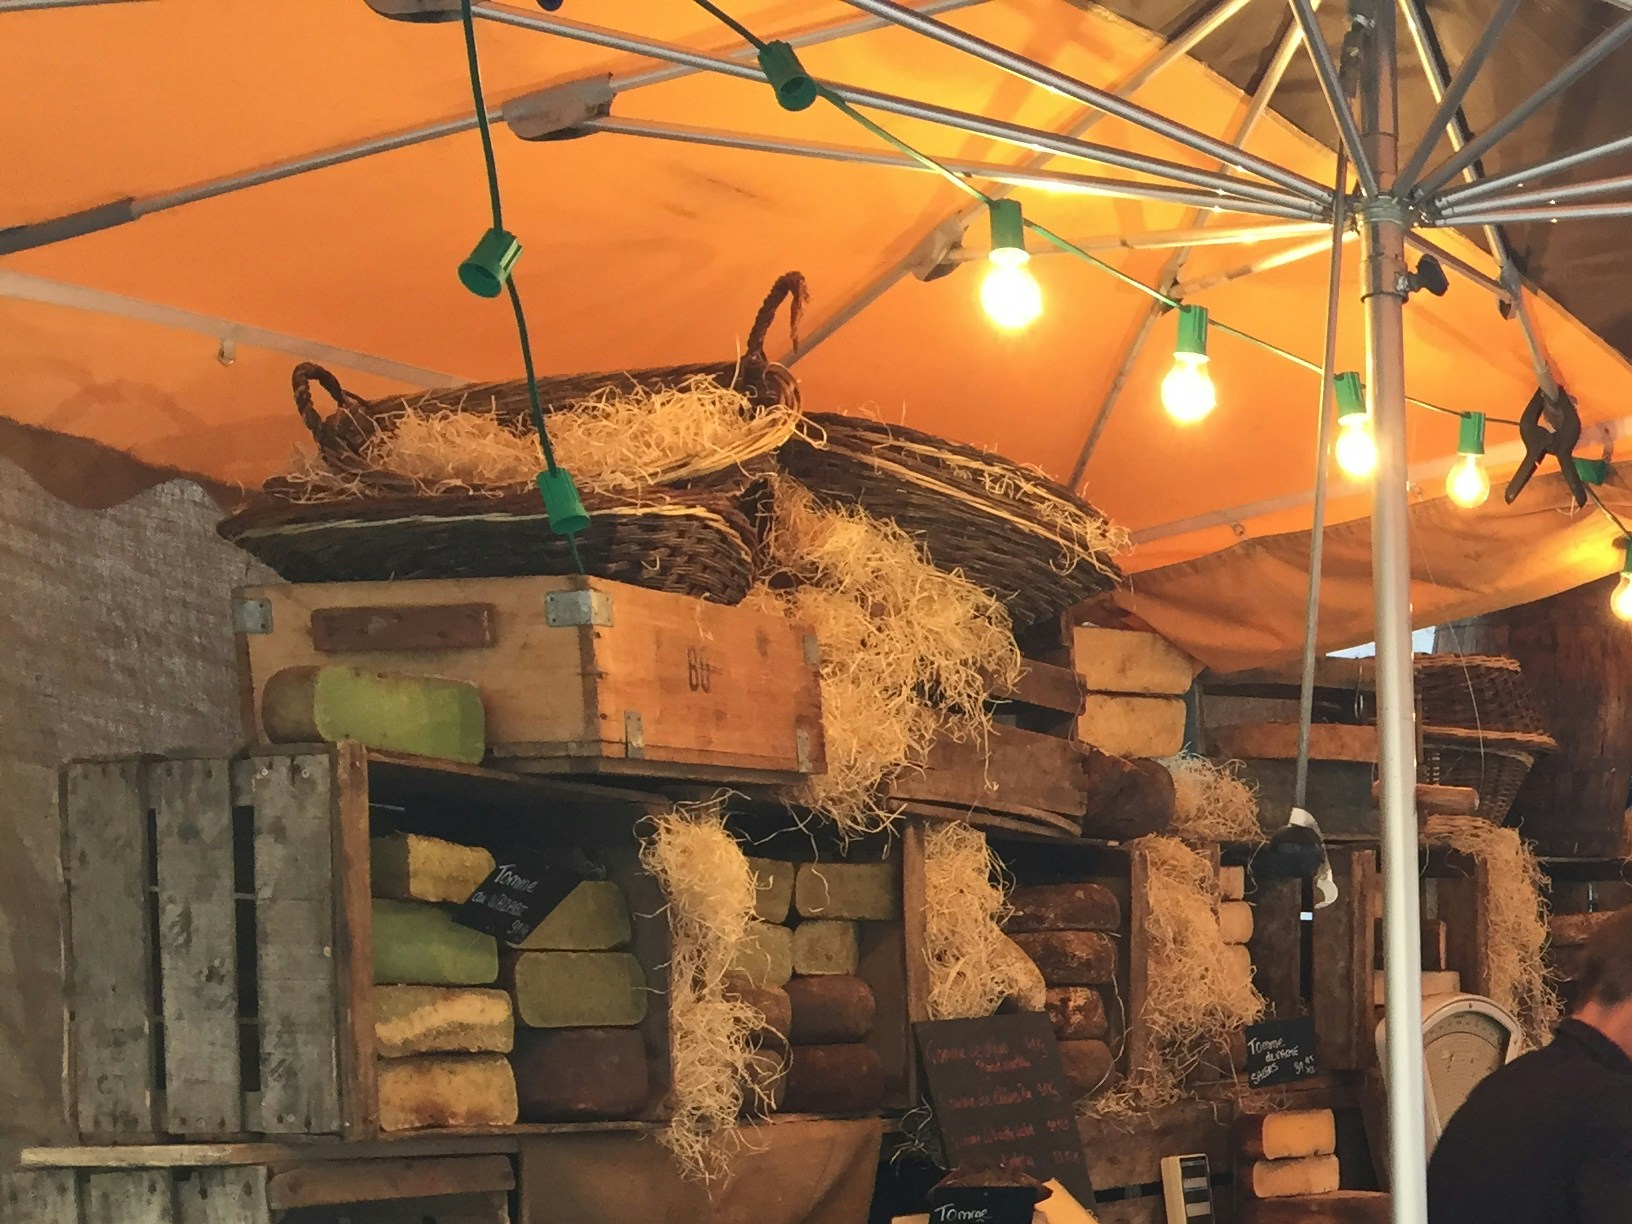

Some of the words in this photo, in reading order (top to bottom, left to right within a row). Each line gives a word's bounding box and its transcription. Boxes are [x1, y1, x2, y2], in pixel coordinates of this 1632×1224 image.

[494, 863, 538, 893] Tomme
[1247, 1037, 1286, 1055] Tomme
[934, 1203, 992, 1222] Tomme
